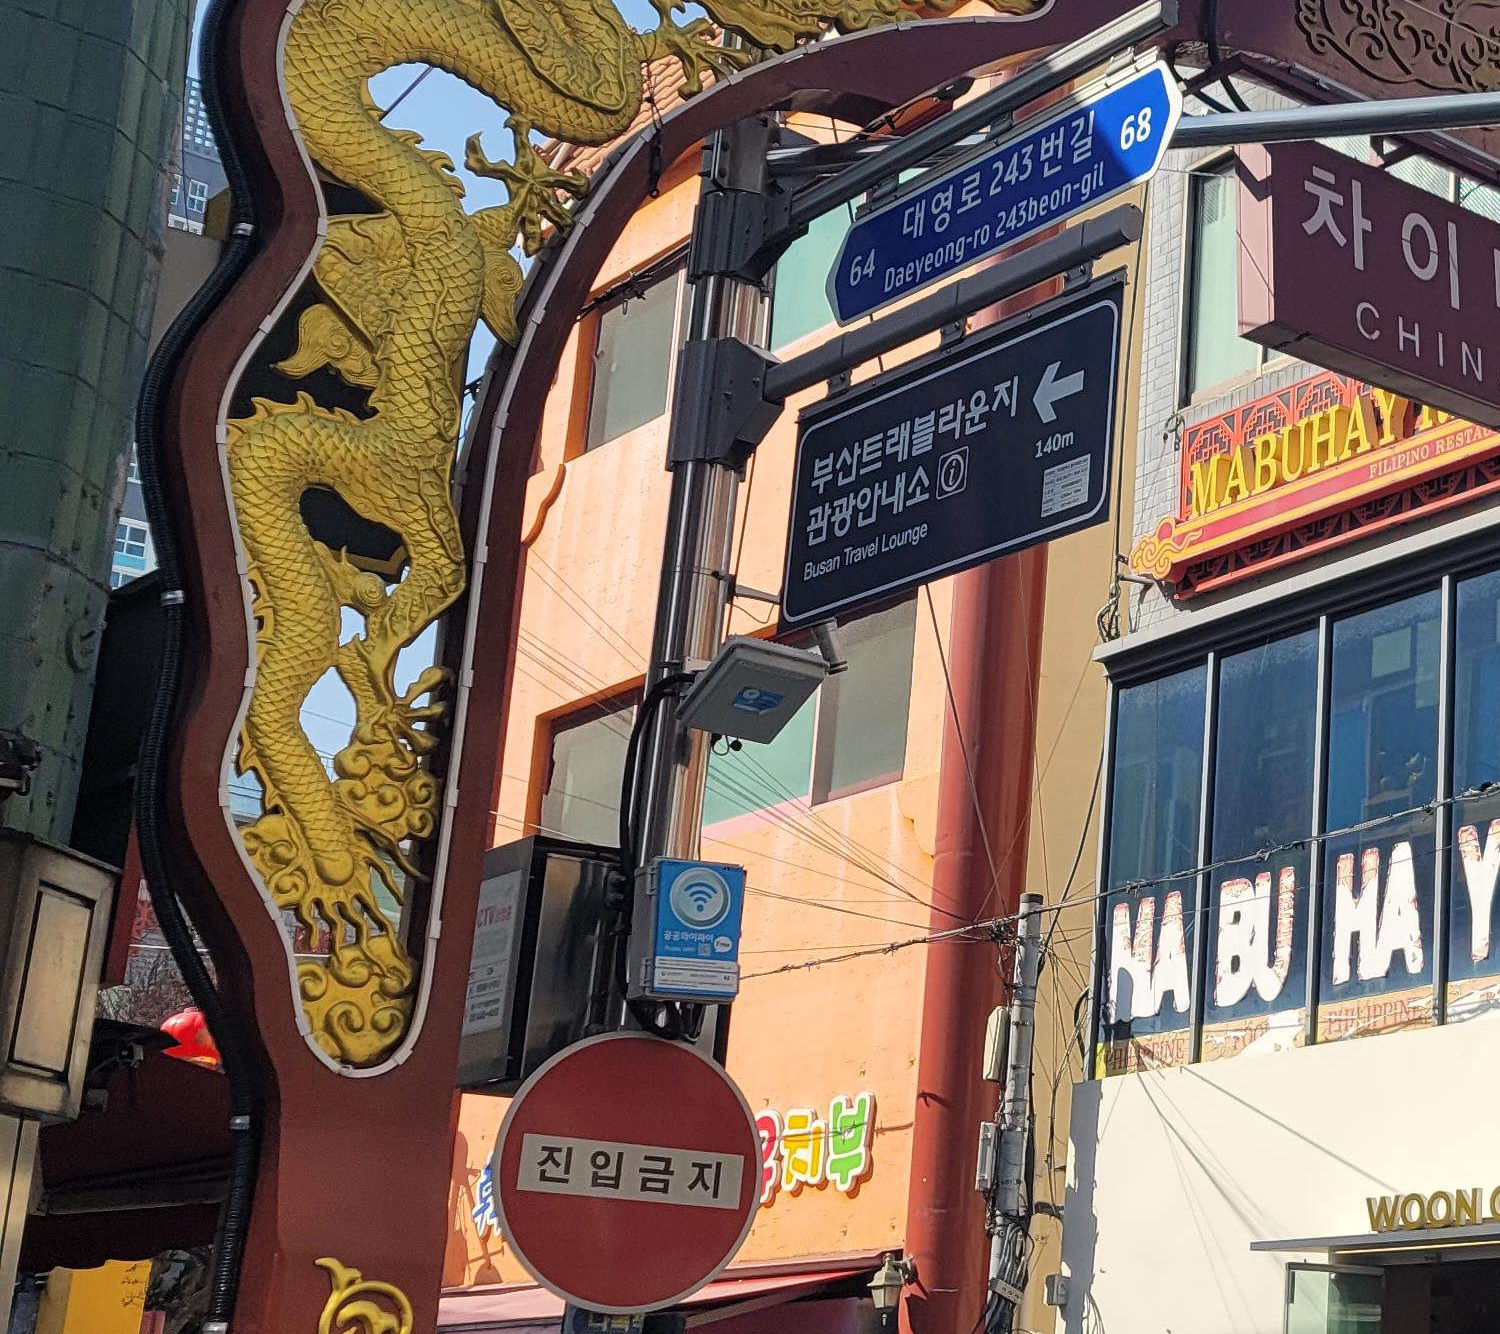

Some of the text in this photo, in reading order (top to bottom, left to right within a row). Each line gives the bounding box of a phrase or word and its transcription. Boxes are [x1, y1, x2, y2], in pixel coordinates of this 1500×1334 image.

[1118, 107, 1152, 152] 68
[883, 161, 1104, 293] Daeyeong-ro 243beon-gil
[848, 248, 876, 286] 64
[810, 376, 1020, 495] 부산트래블라운지
[1034, 431, 1074, 459] 140m
[1191, 391, 1400, 519] MABUHAY
[1369, 424, 1492, 479] FILIPINO RESTAU
[806, 466, 931, 548] 관광안내소
[803, 521, 928, 581] Busan Travel Lounge
[535, 1142, 725, 1200] 진입금지
[1365, 1186, 1484, 1234] WOON
